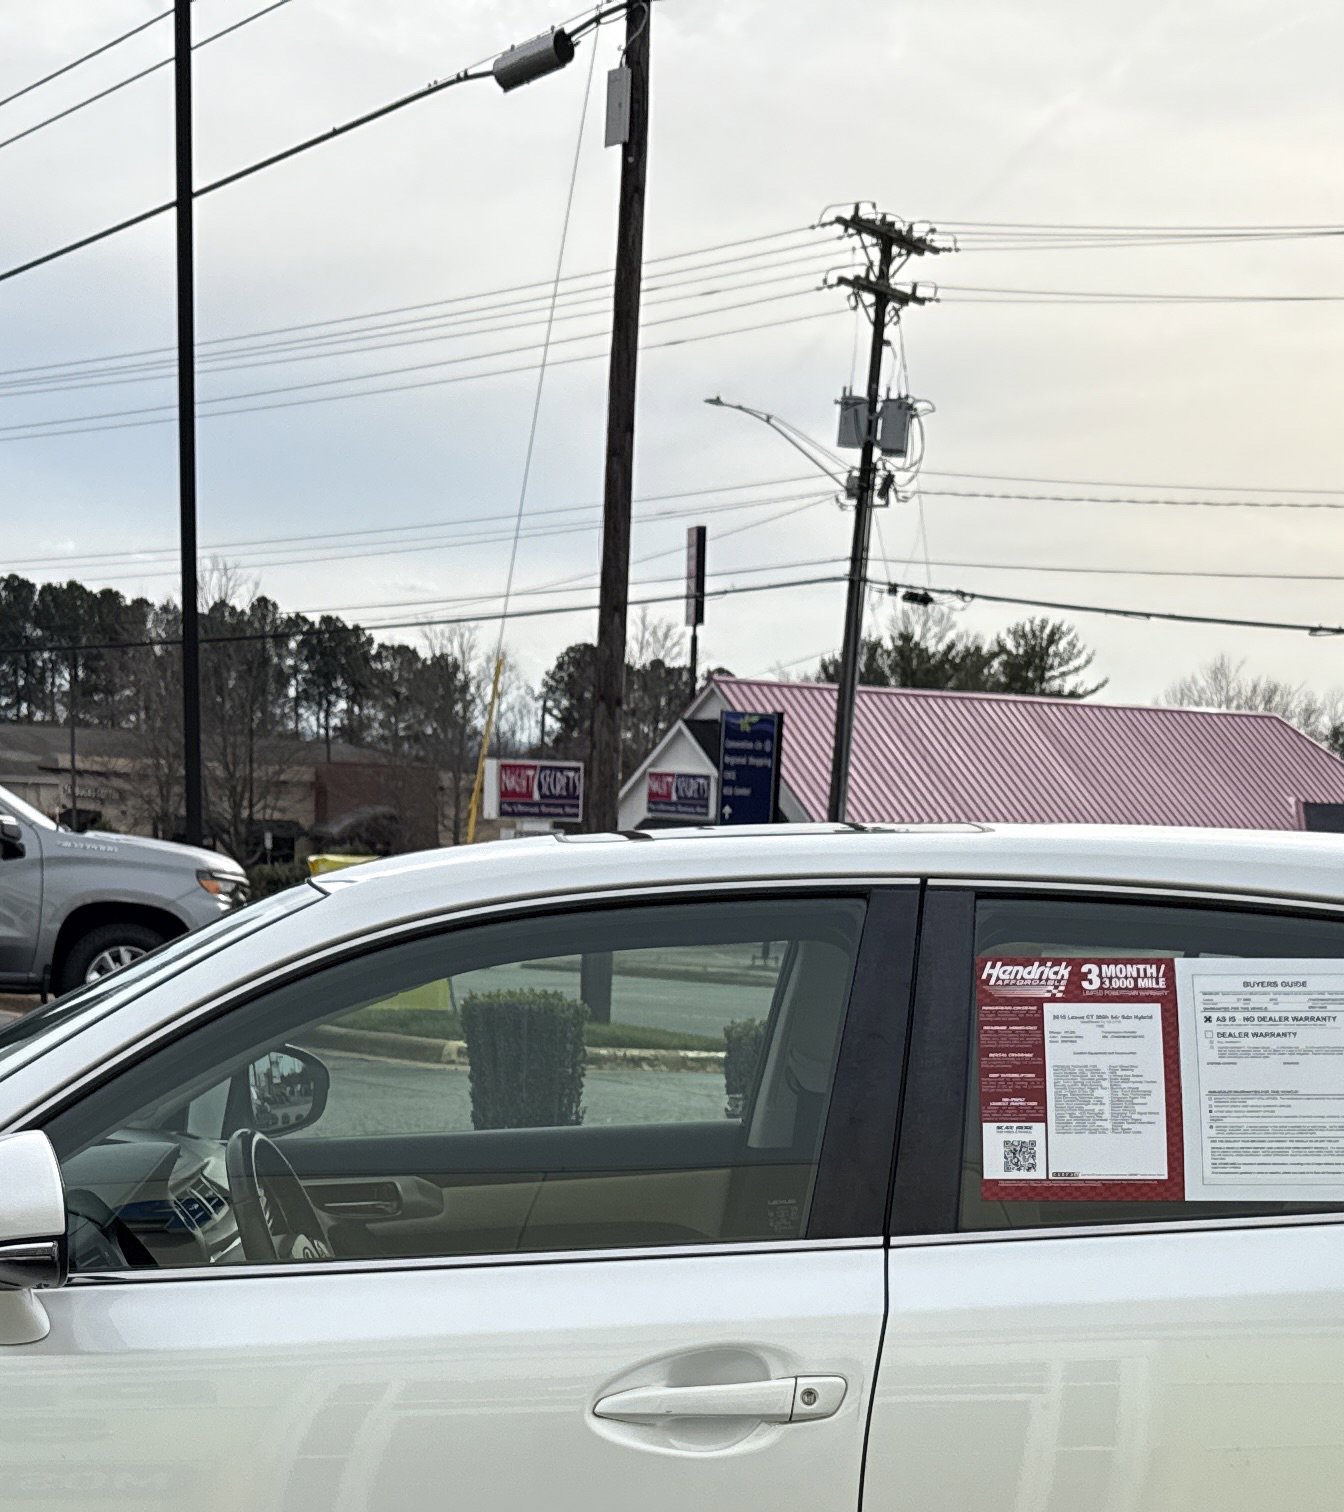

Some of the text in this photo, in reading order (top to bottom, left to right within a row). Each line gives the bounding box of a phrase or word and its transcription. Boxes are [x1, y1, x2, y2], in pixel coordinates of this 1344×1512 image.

[981, 961, 1072, 986] Hendrick
[1080, 963, 1165, 990] 3 MONTH/
[1102, 978, 1166, 989] 3,000 MILE
